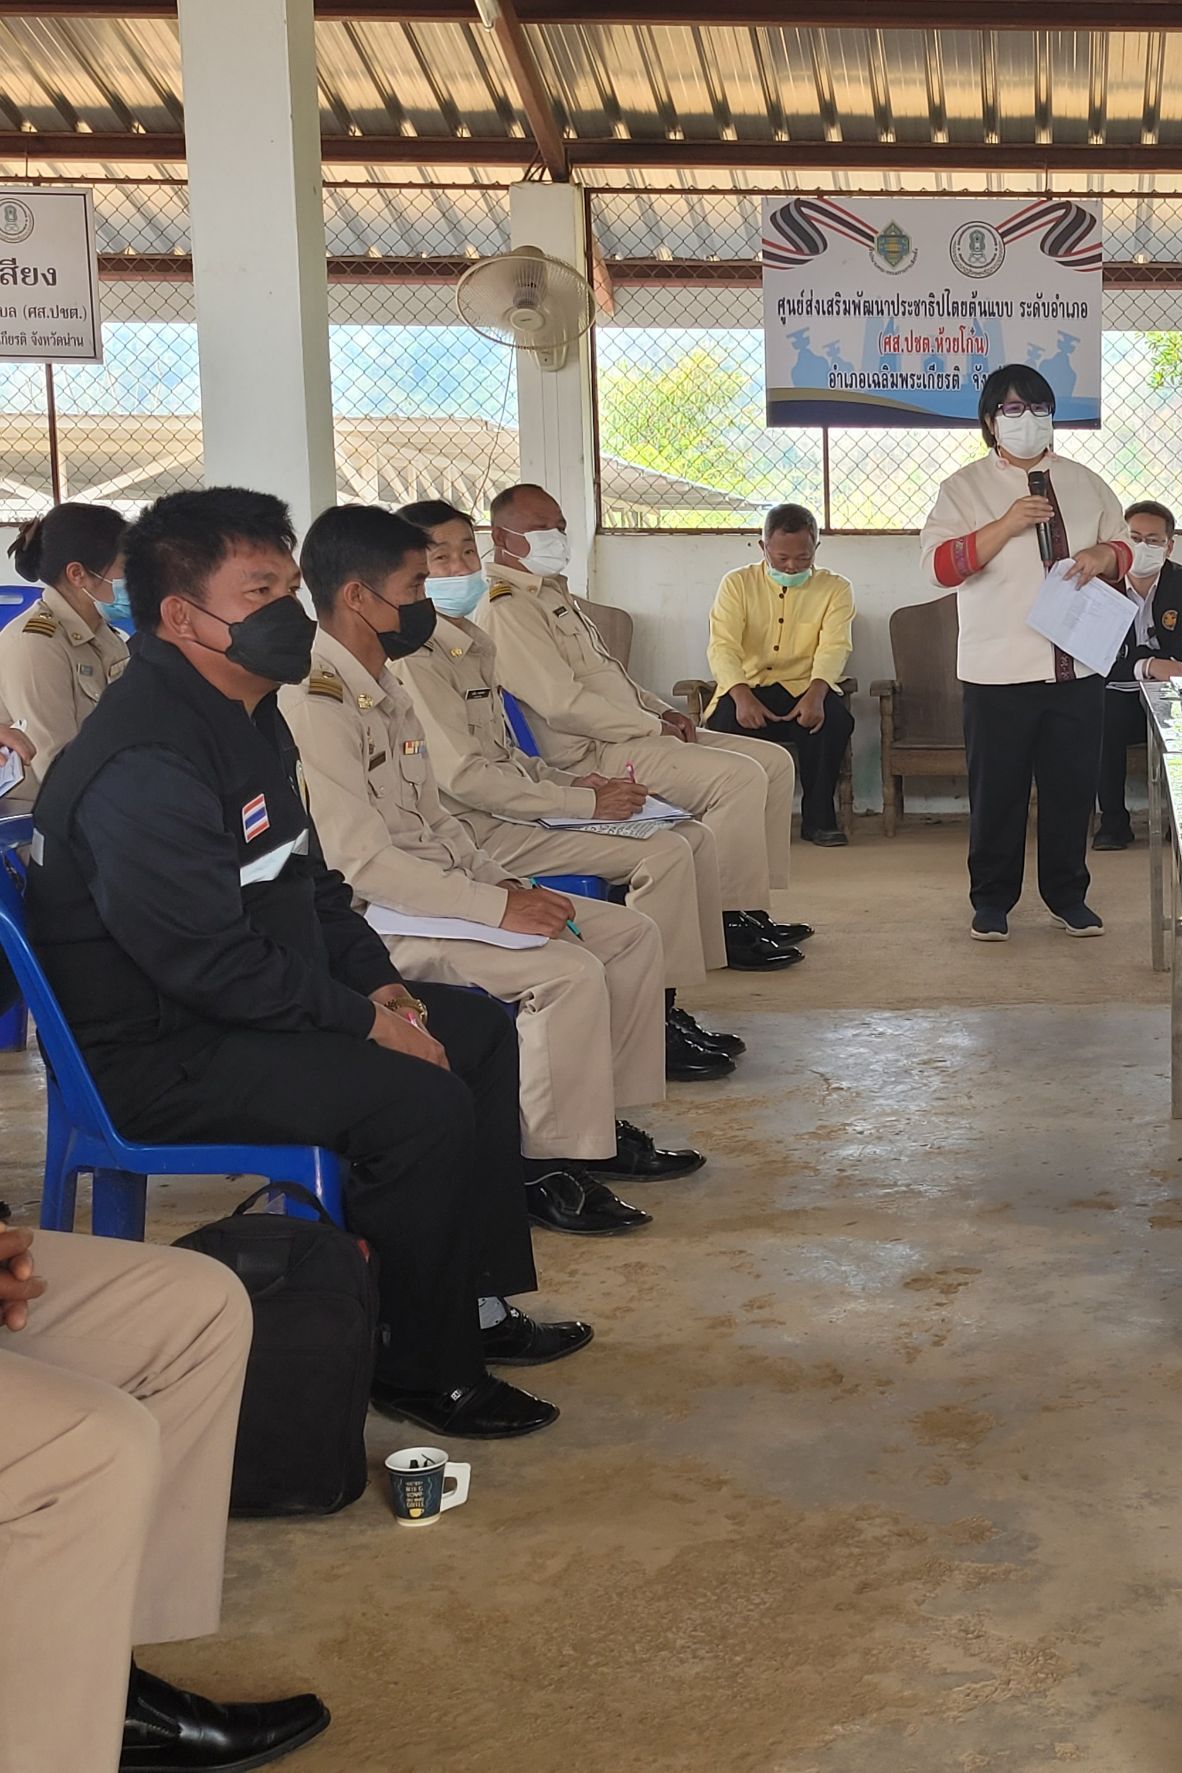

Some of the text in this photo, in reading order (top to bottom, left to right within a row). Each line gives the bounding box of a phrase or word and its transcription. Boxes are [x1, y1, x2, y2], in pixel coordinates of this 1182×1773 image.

[1019, 292, 1088, 319] ระดับอำเภอ
[31, 331, 85, 348] จังหวัดน่าน
[828, 363, 960, 390] อำเภอเฉลิมพระเกียรติ
